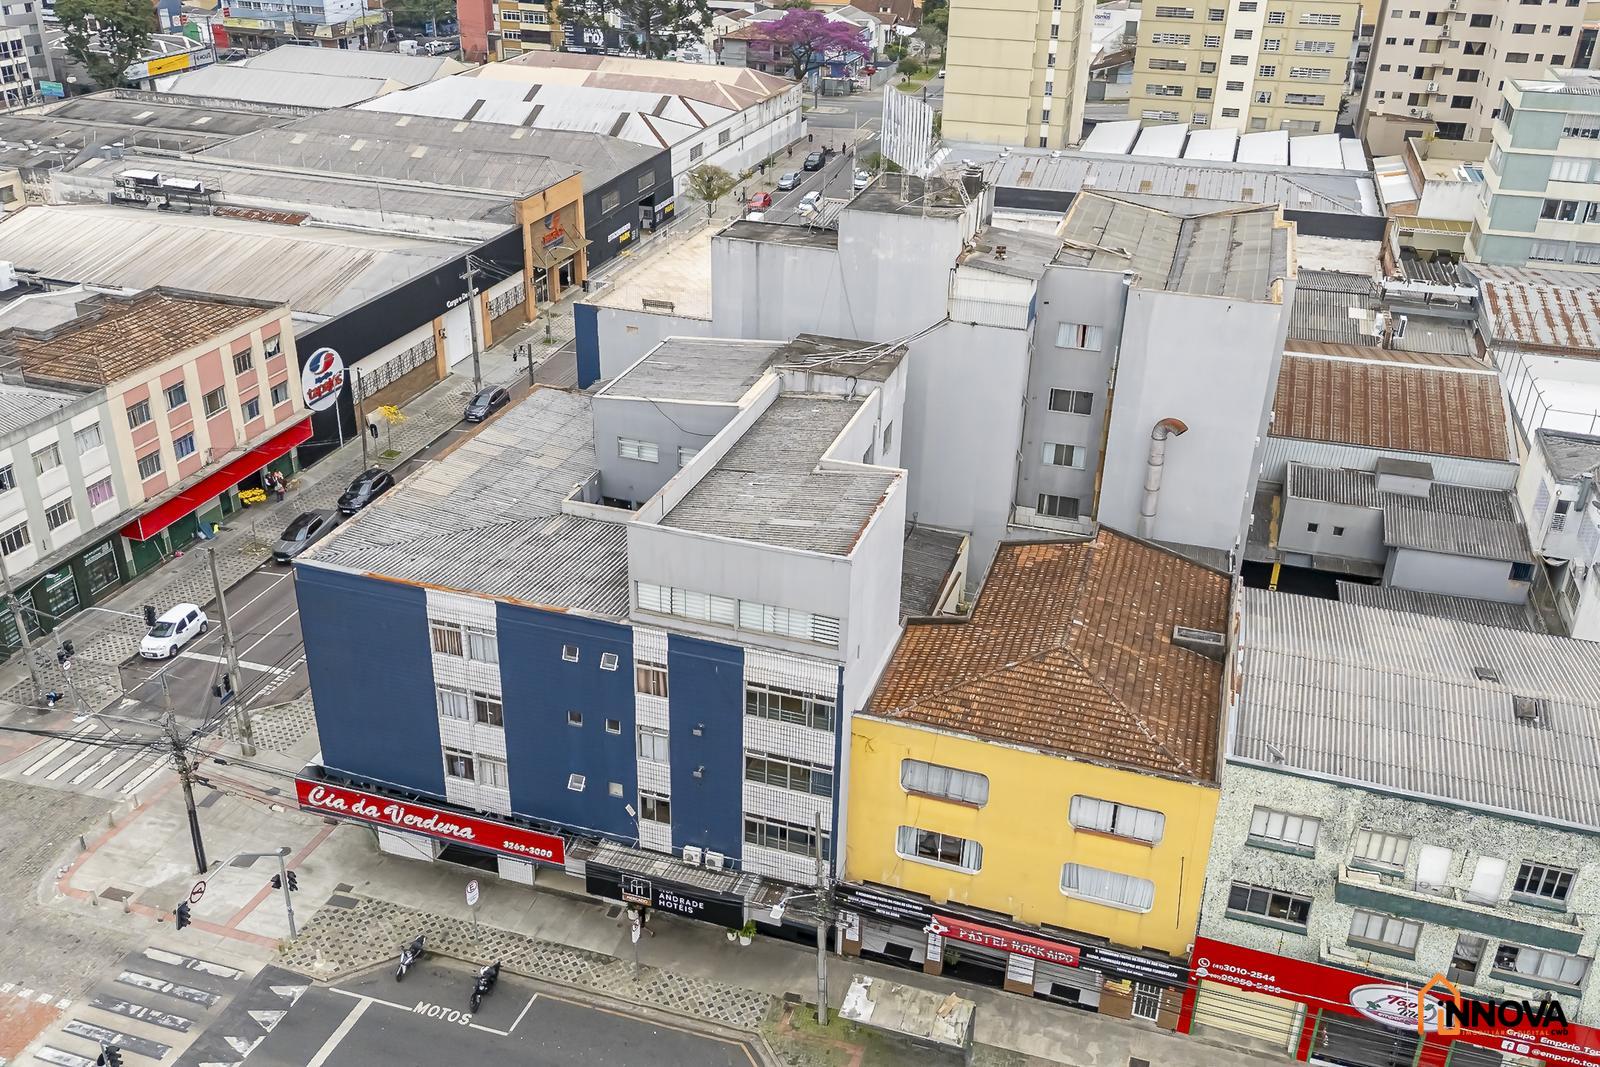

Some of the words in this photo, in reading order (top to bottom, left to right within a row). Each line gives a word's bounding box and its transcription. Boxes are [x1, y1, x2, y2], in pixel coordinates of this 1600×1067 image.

[308, 786, 348, 810] Cia
[352, 799, 380, 817] da
[384, 804, 475, 839] Verdura
[503, 840, 552, 858] 3263-3000
[658, 893, 704, 909] ANDRADE
[959, 928, 1008, 947] PASTEL
[413, 1001, 472, 1025] MOTOS
[1506, 1029, 1536, 1041] Grupo
[1540, 1036, 1581, 1052] Empório
